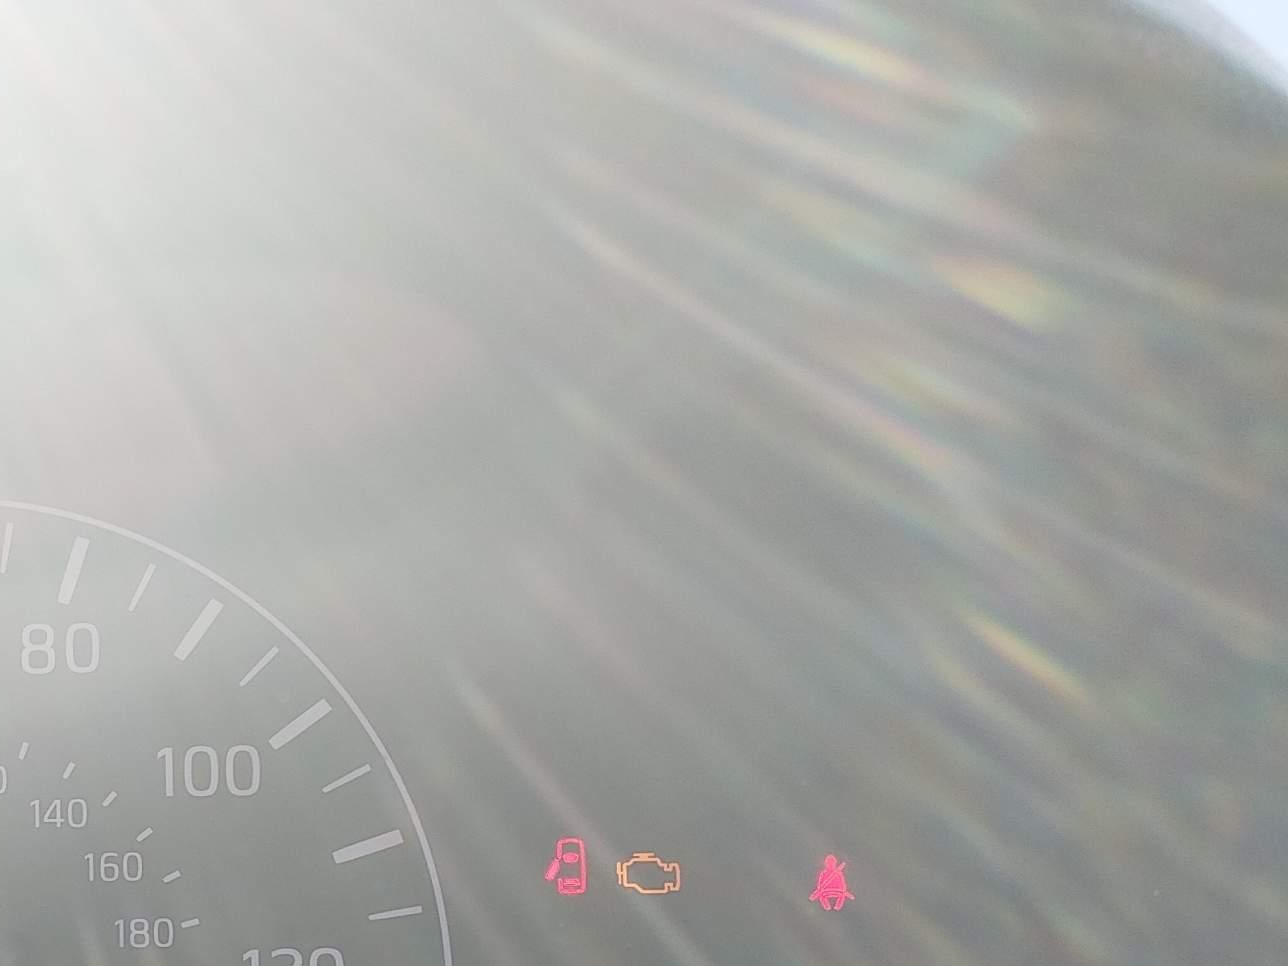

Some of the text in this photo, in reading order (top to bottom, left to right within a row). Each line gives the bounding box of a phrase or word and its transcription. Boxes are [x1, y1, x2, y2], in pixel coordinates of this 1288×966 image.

[20, 623, 100, 675] 80
[155, 745, 260, 798] 100
[29, 800, 88, 828] 140
[84, 853, 143, 881] 160
[114, 919, 174, 949] 180
